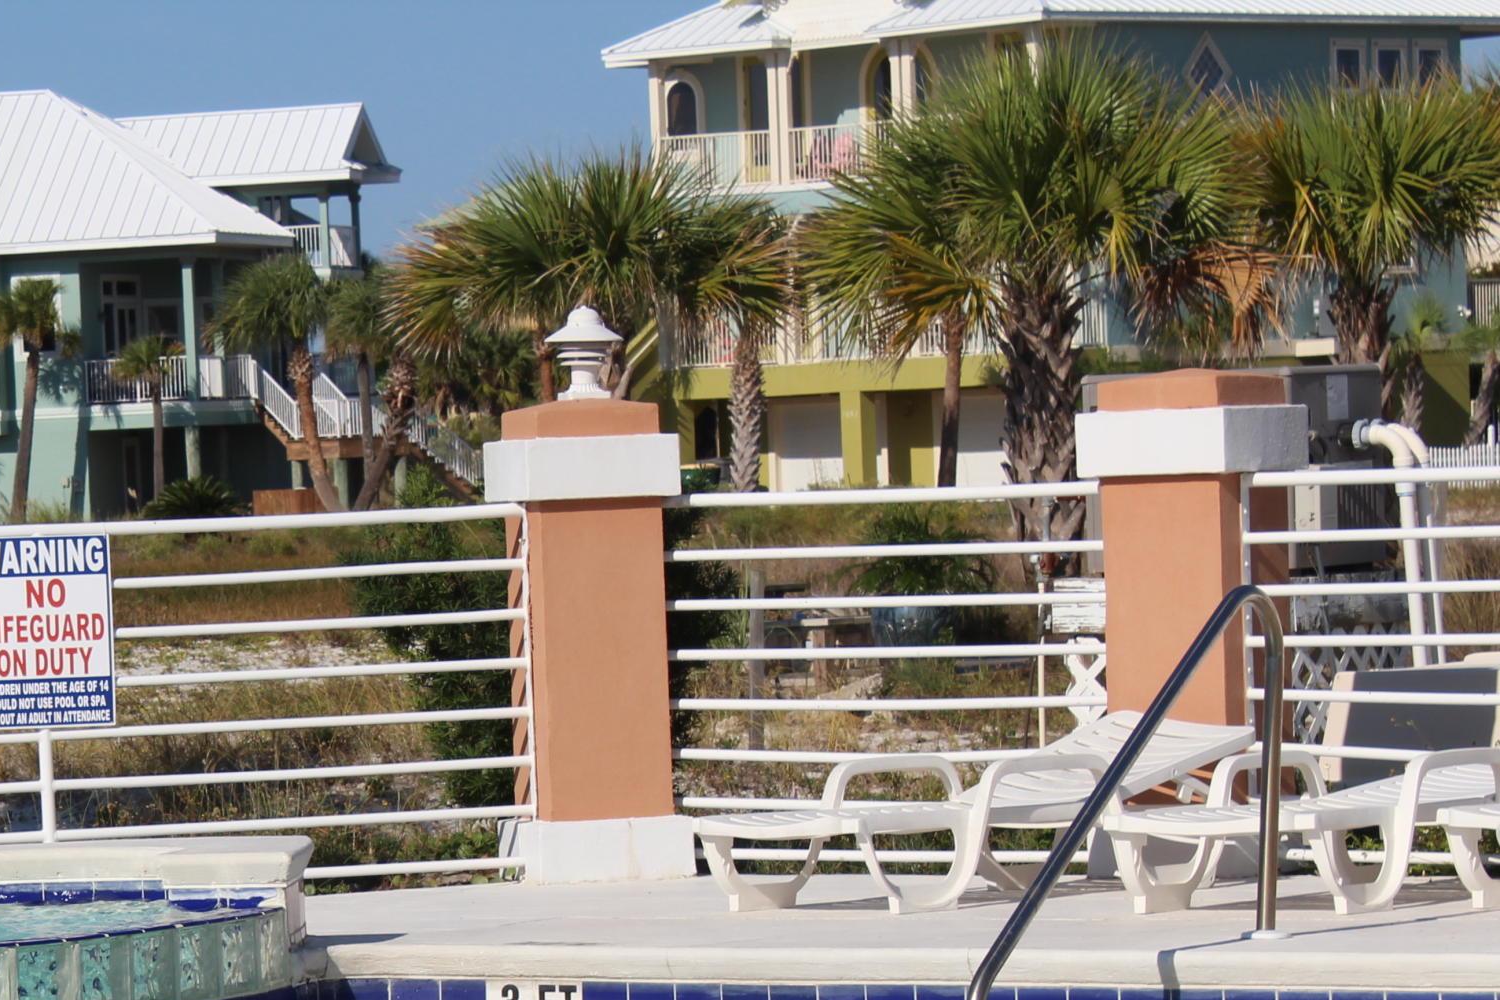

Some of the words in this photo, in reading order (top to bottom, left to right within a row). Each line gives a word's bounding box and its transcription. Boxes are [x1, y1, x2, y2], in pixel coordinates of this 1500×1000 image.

[25, 578, 66, 609] NO
[35, 646, 93, 676] DUTY
[22, 682, 51, 695] UNDER
[51, 681, 68, 694] THE
[69, 681, 86, 693] AGE
[87, 680, 98, 692] OF
[99, 680, 110, 692] 14
[18, 697, 36, 710] NOT
[37, 696, 54, 709] USE
[54, 696, 77, 708] POOL
[77, 695, 90, 707] OR
[90, 694, 107, 707] SPA
[16, 712, 28, 725] AN
[28, 711, 52, 724] ADULT
[53, 710, 62, 723] IN
[62, 709, 111, 723] ATTENDANCE
